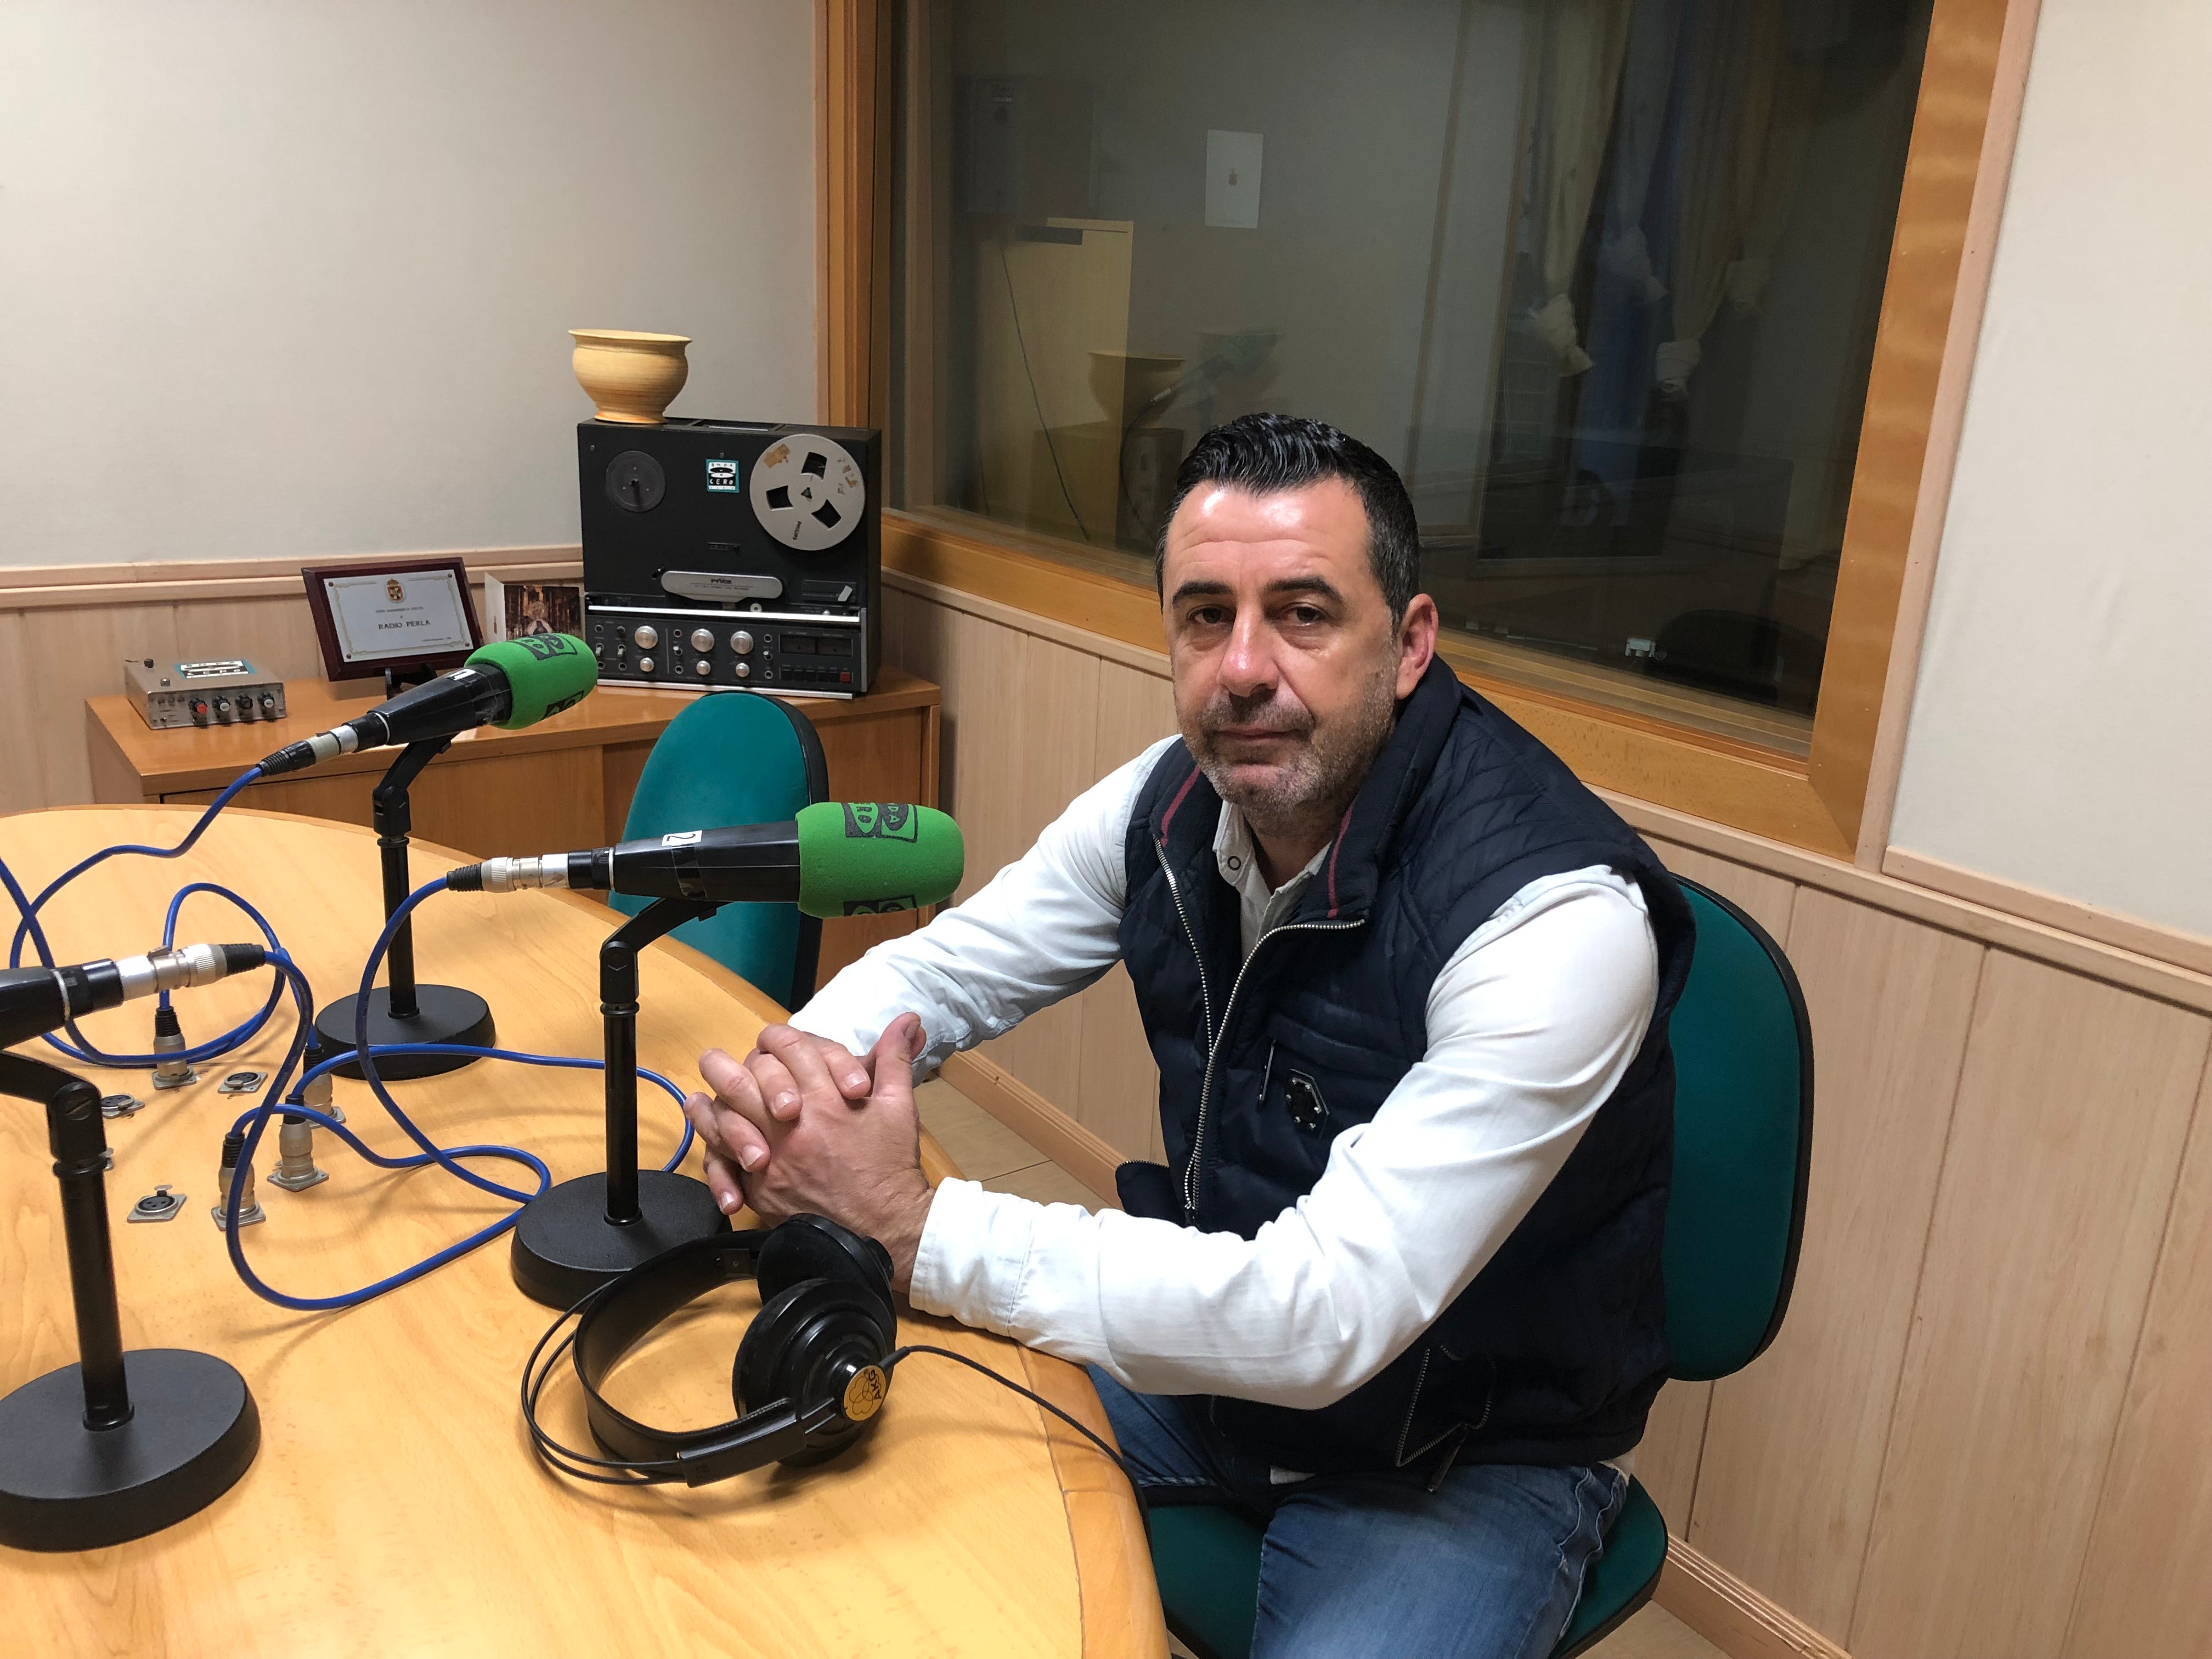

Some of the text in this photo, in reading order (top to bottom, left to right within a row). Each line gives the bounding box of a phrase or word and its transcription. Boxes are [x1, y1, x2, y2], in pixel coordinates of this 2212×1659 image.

[792, 521, 801, 540] PHILIPS
[666, 833, 696, 842] 2
[868, 1369, 882, 1400] AKG
